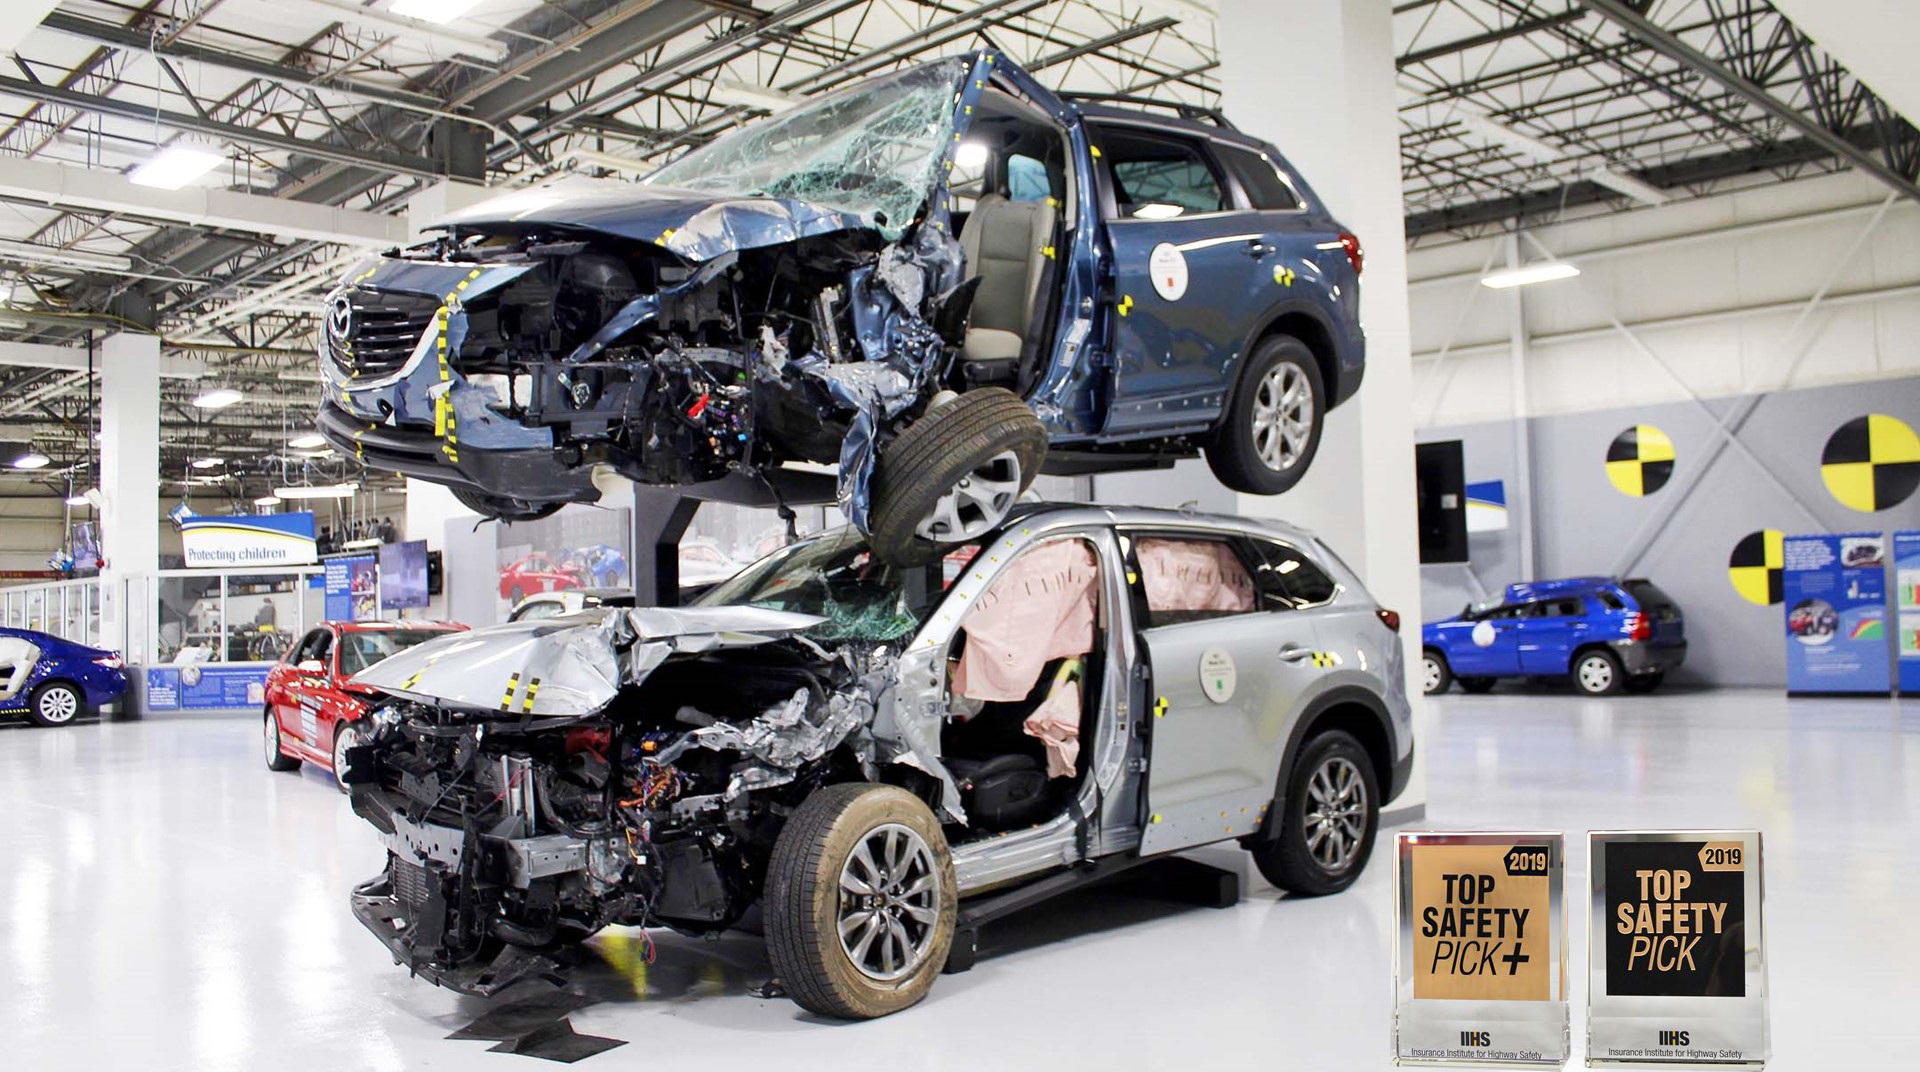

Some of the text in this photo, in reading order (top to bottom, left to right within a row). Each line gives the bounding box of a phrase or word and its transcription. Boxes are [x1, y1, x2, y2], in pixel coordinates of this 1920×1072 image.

[188, 547, 286, 562] Protecting children
[1509, 853, 1545, 871] 2019
[1705, 849, 1741, 865] 2019
[1442, 874, 1495, 905] TOP
[1636, 869, 1691, 902] TOP
[1422, 907, 1530, 939] SAFETY
[1617, 902, 1728, 935] SAFETY
[1628, 936, 1701, 972] PICK
[1461, 1031, 1491, 1047] IIHS
[1659, 1030, 1690, 1046] IIHS
[1411, 1048, 1542, 1060] Insurance Institute for Highway Safety
[1608, 1048, 1743, 1059] Insurance Institute for Highway Safety
